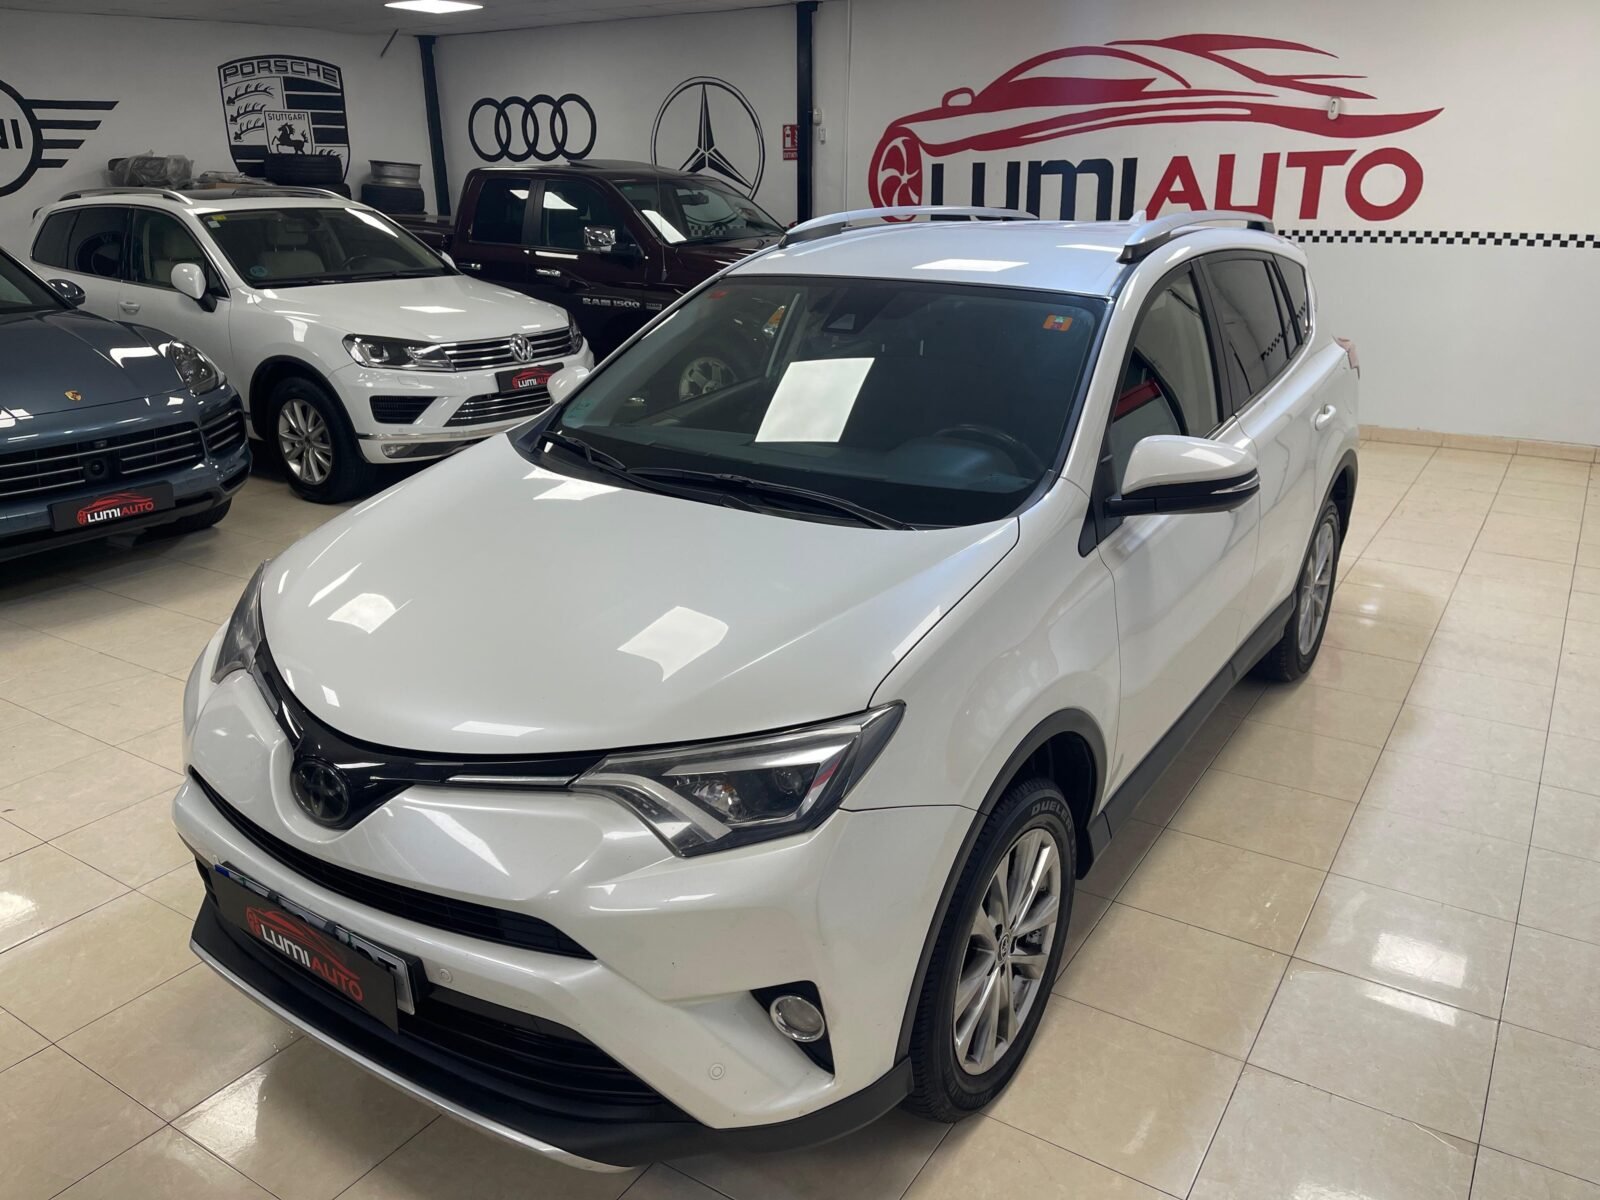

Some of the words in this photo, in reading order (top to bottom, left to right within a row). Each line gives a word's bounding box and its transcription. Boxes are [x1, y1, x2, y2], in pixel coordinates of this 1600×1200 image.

[222, 60, 339, 84] PORSCHE
[267, 113, 306, 121] STUTTGART
[582, 297, 611, 306] RAM
[613, 300, 640, 308] 1500
[1031, 801, 1072, 832] DUELER
